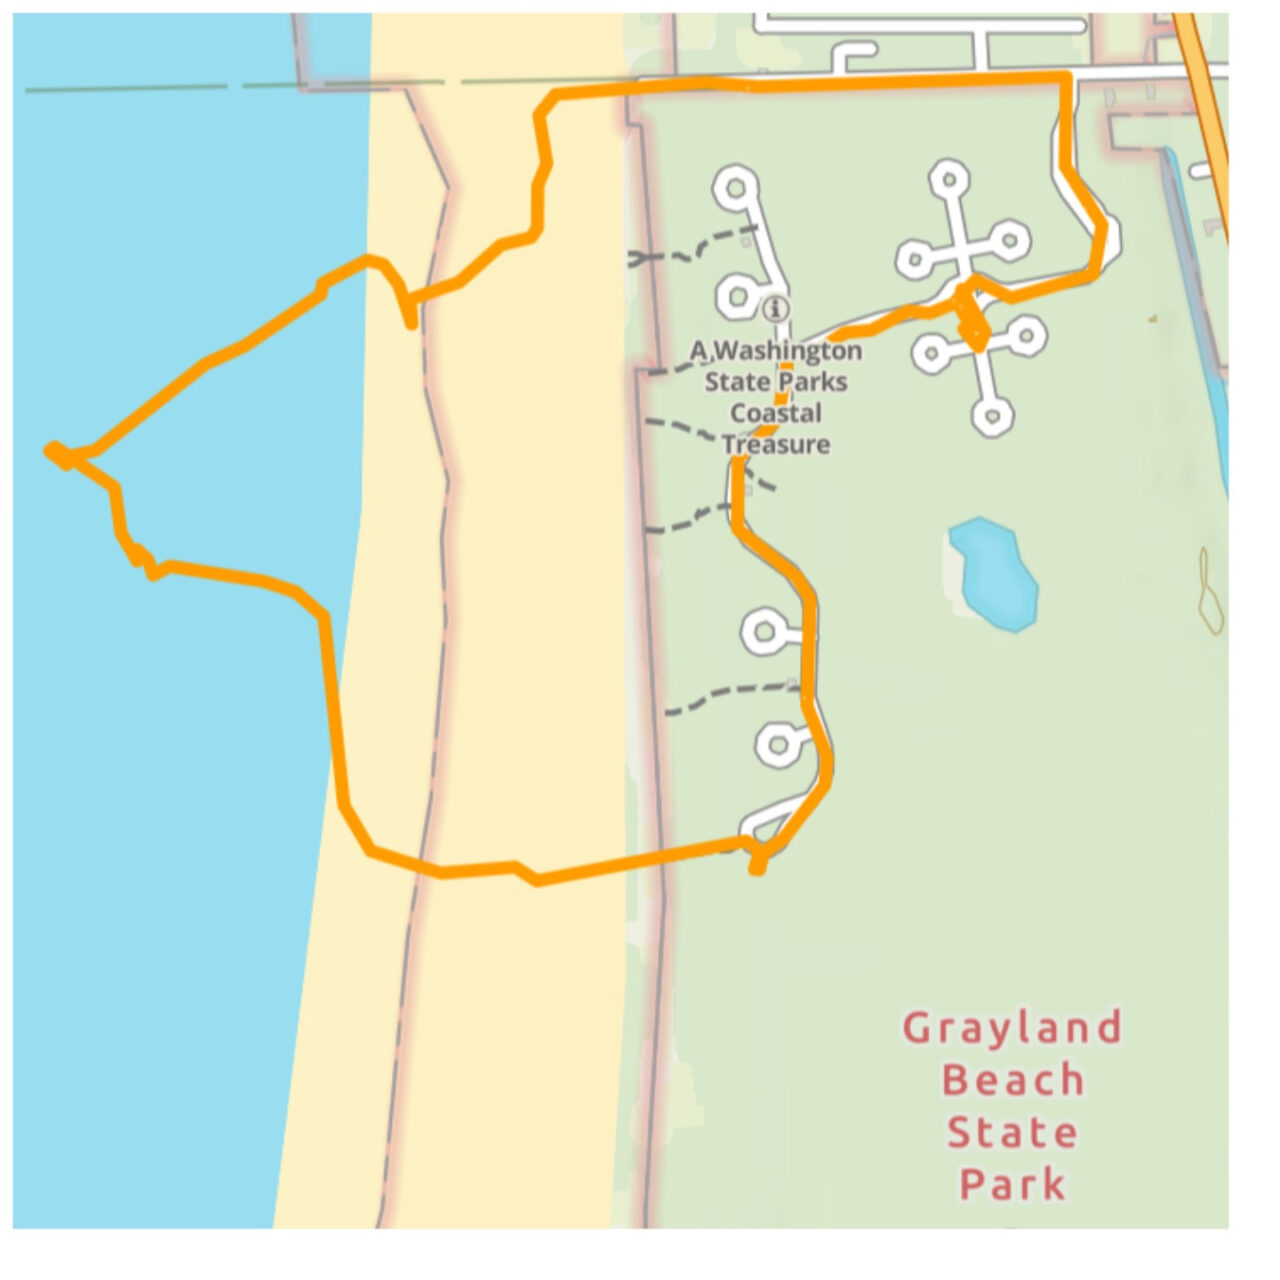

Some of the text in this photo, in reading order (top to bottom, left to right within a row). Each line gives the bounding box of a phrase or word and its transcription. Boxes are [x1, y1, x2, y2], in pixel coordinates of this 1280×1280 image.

[690, 340, 862, 365] A Washington
[705, 371, 848, 392] State Parks
[731, 402, 822, 423] Coastal
[722, 435, 831, 455] Treasure
[903, 1008, 1121, 1051] Grayland
[943, 1060, 1083, 1097] Beach
[947, 1115, 1077, 1149] State
[961, 1166, 1065, 1201] Park
